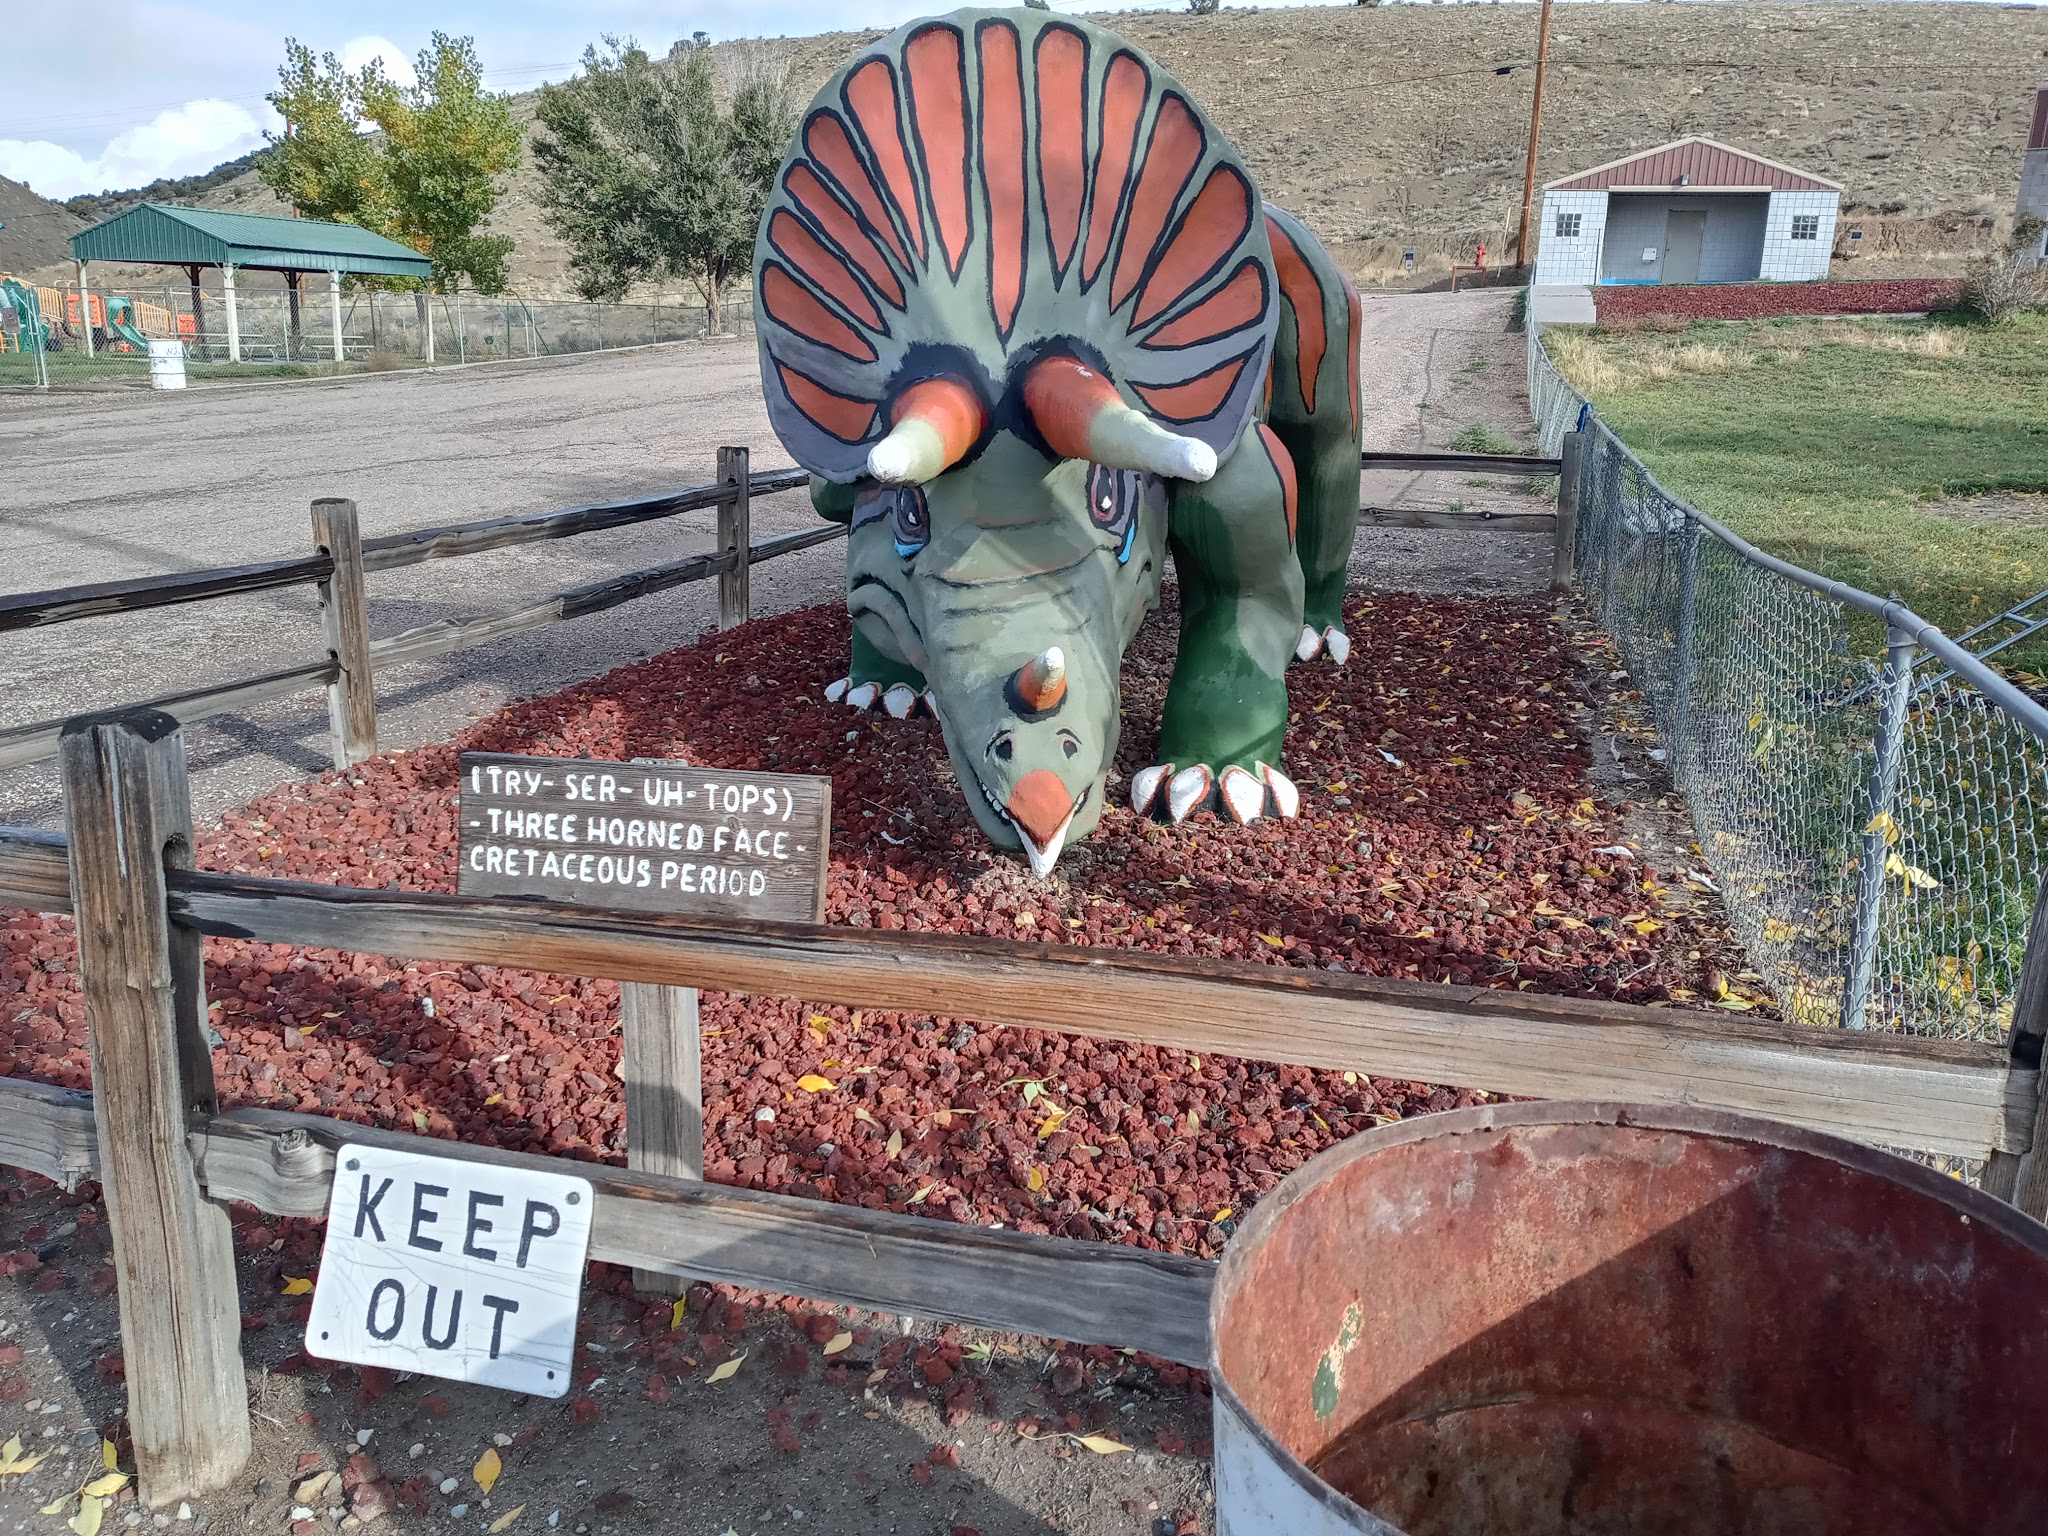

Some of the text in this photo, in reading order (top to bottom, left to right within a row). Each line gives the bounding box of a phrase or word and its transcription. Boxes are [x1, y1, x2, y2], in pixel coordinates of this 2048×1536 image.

[566, 774, 632, 802] SER-
[643, 778, 696, 806] UH-
[704, 783, 794, 821] TOPS)
[587, 817, 703, 851] HORNED
[470, 845, 766, 897] CRETACEOUS PERIOD
[353, 1173, 561, 1268] KEEP
[366, 1278, 519, 1360] OUT
